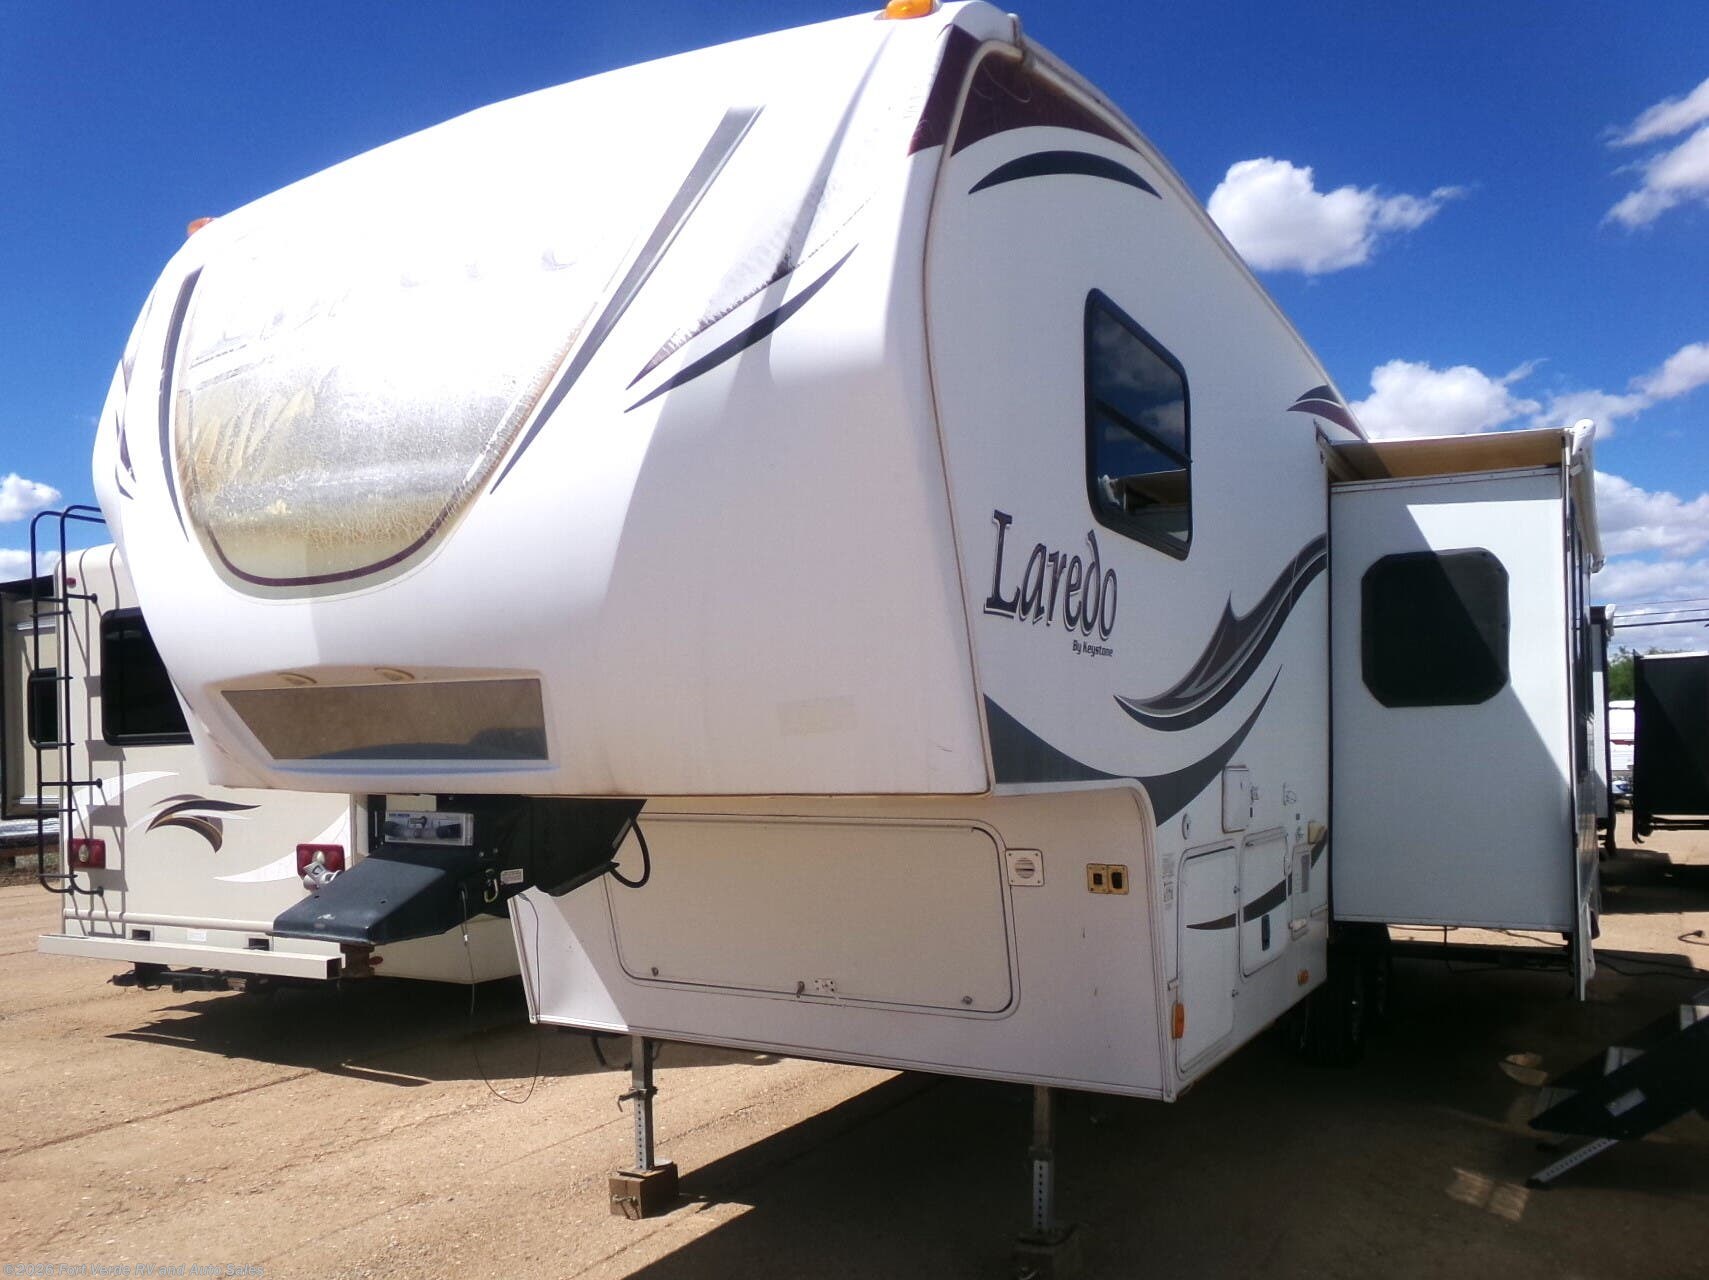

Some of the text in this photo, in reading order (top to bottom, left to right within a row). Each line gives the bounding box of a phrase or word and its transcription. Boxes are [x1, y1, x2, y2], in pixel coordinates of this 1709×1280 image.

[984, 509, 1118, 641] Laredo
[1072, 639, 1114, 657] By Keystone
